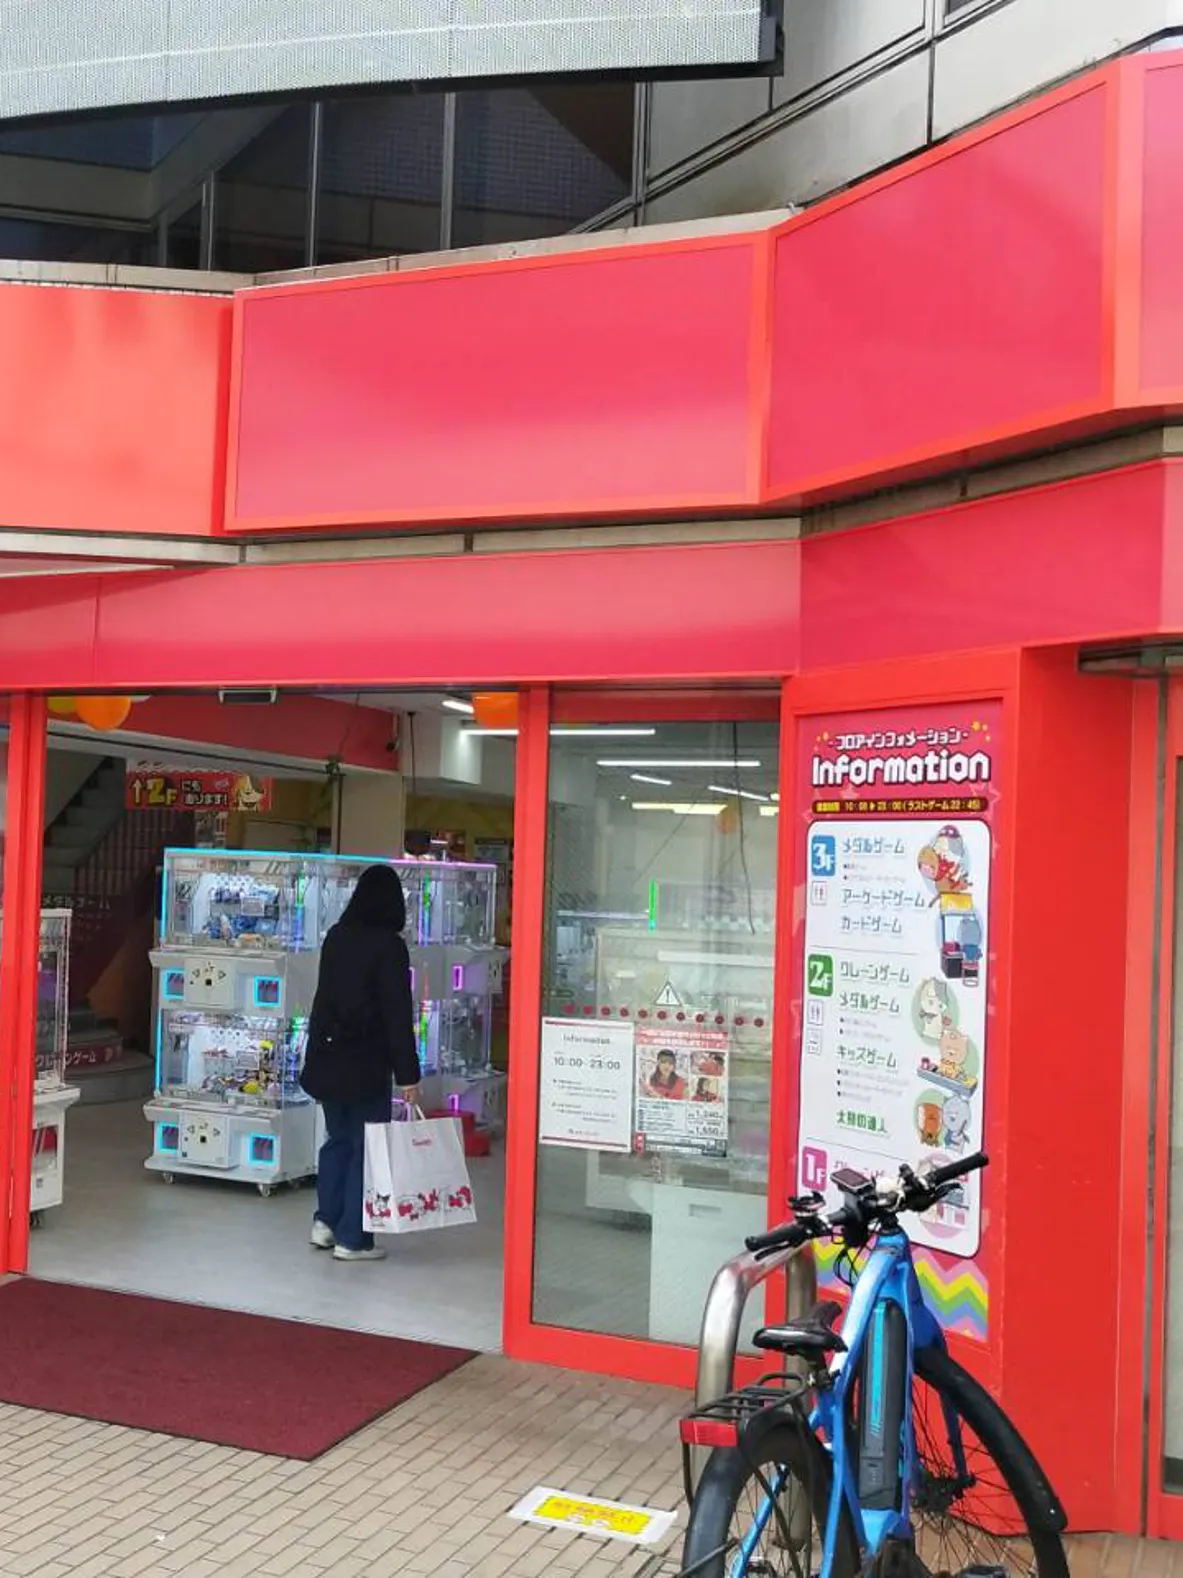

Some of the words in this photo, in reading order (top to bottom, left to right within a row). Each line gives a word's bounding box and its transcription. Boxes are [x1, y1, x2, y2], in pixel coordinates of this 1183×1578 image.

[812, 749, 991, 786] Information
[146, 778, 177, 806] 2F
[813, 842, 834, 871] 3F
[842, 837, 906, 854] メダルゲーム
[842, 889, 926, 908] アーケードゲーム
[841, 916, 902, 933] カードゲーム
[809, 961, 832, 991] 2F
[839, 961, 910, 983] クレーンゲーム
[838, 992, 900, 1014] メダルゲーム
[837, 1045, 897, 1068] キッズゲーム
[804, 1153, 826, 1185] 1F
